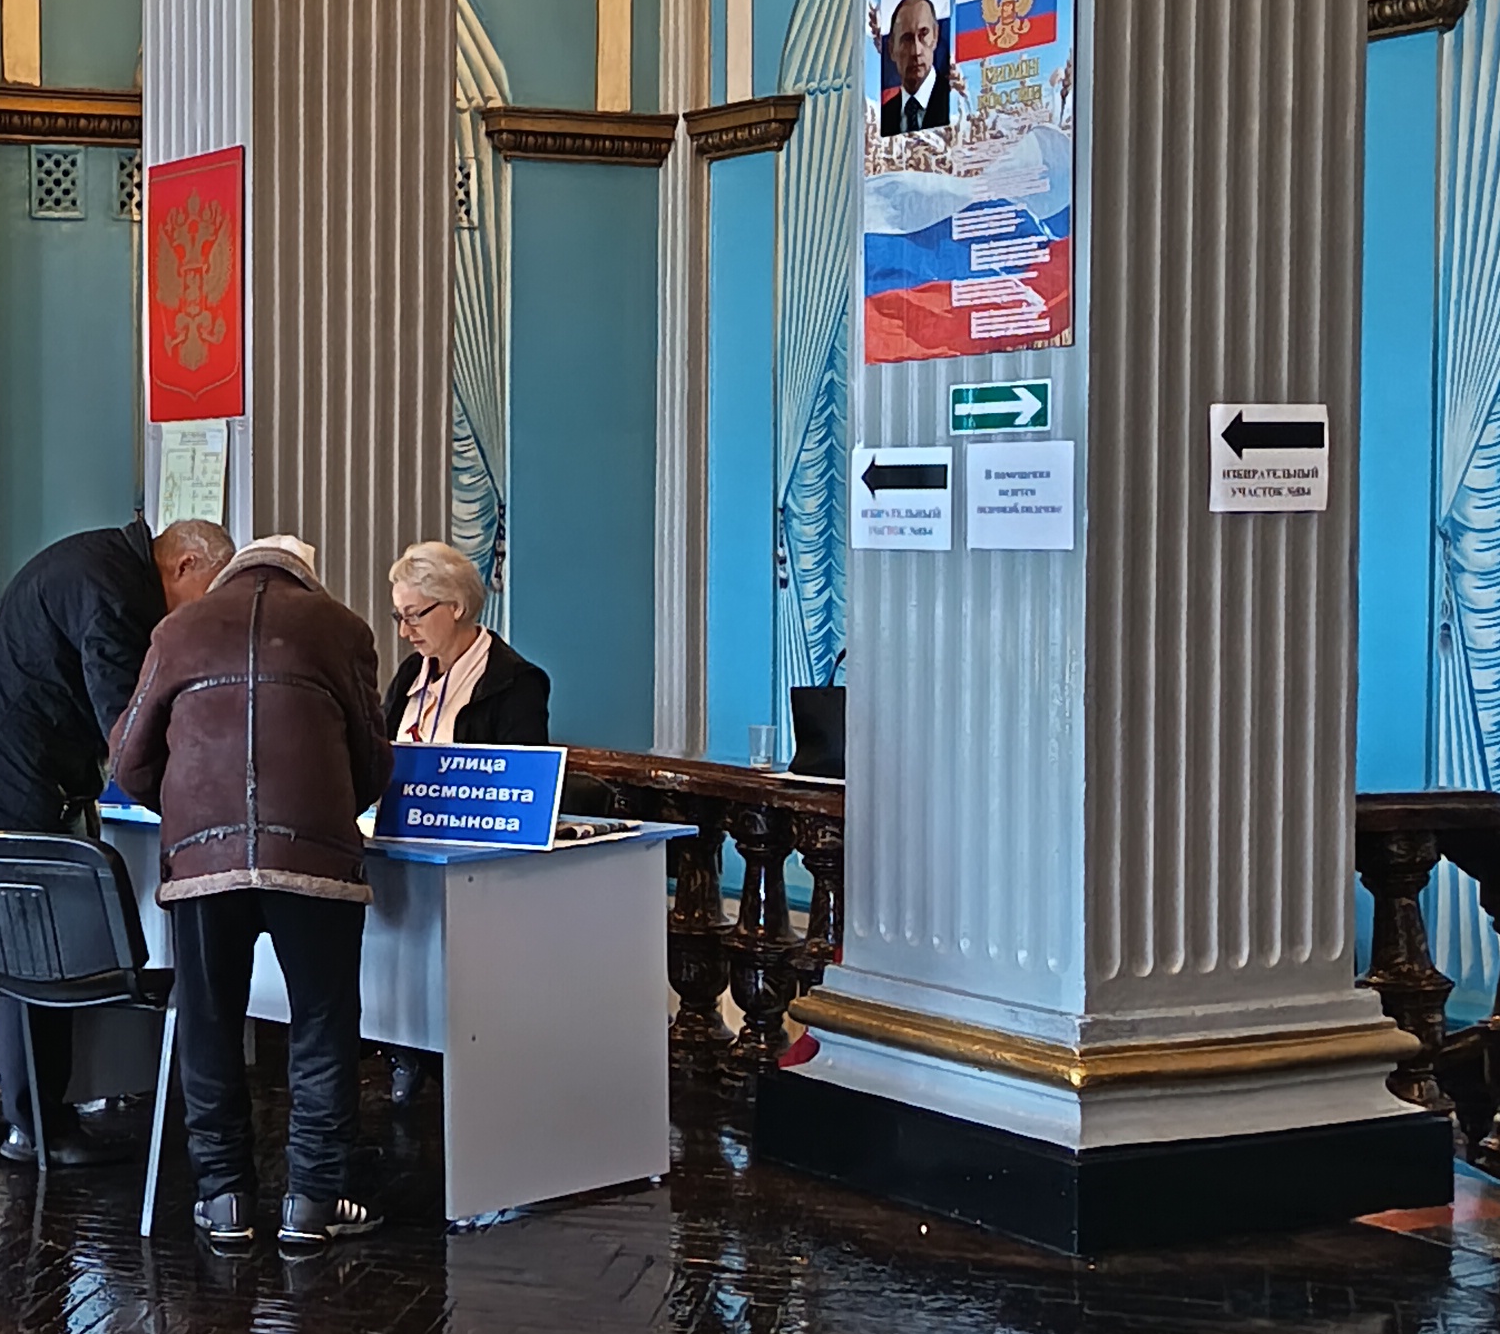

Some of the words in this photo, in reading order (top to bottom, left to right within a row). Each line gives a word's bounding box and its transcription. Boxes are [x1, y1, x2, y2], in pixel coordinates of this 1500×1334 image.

[438, 755, 507, 774] улица
[402, 782, 535, 804] космонавта
[406, 808, 520, 831] Волынова
